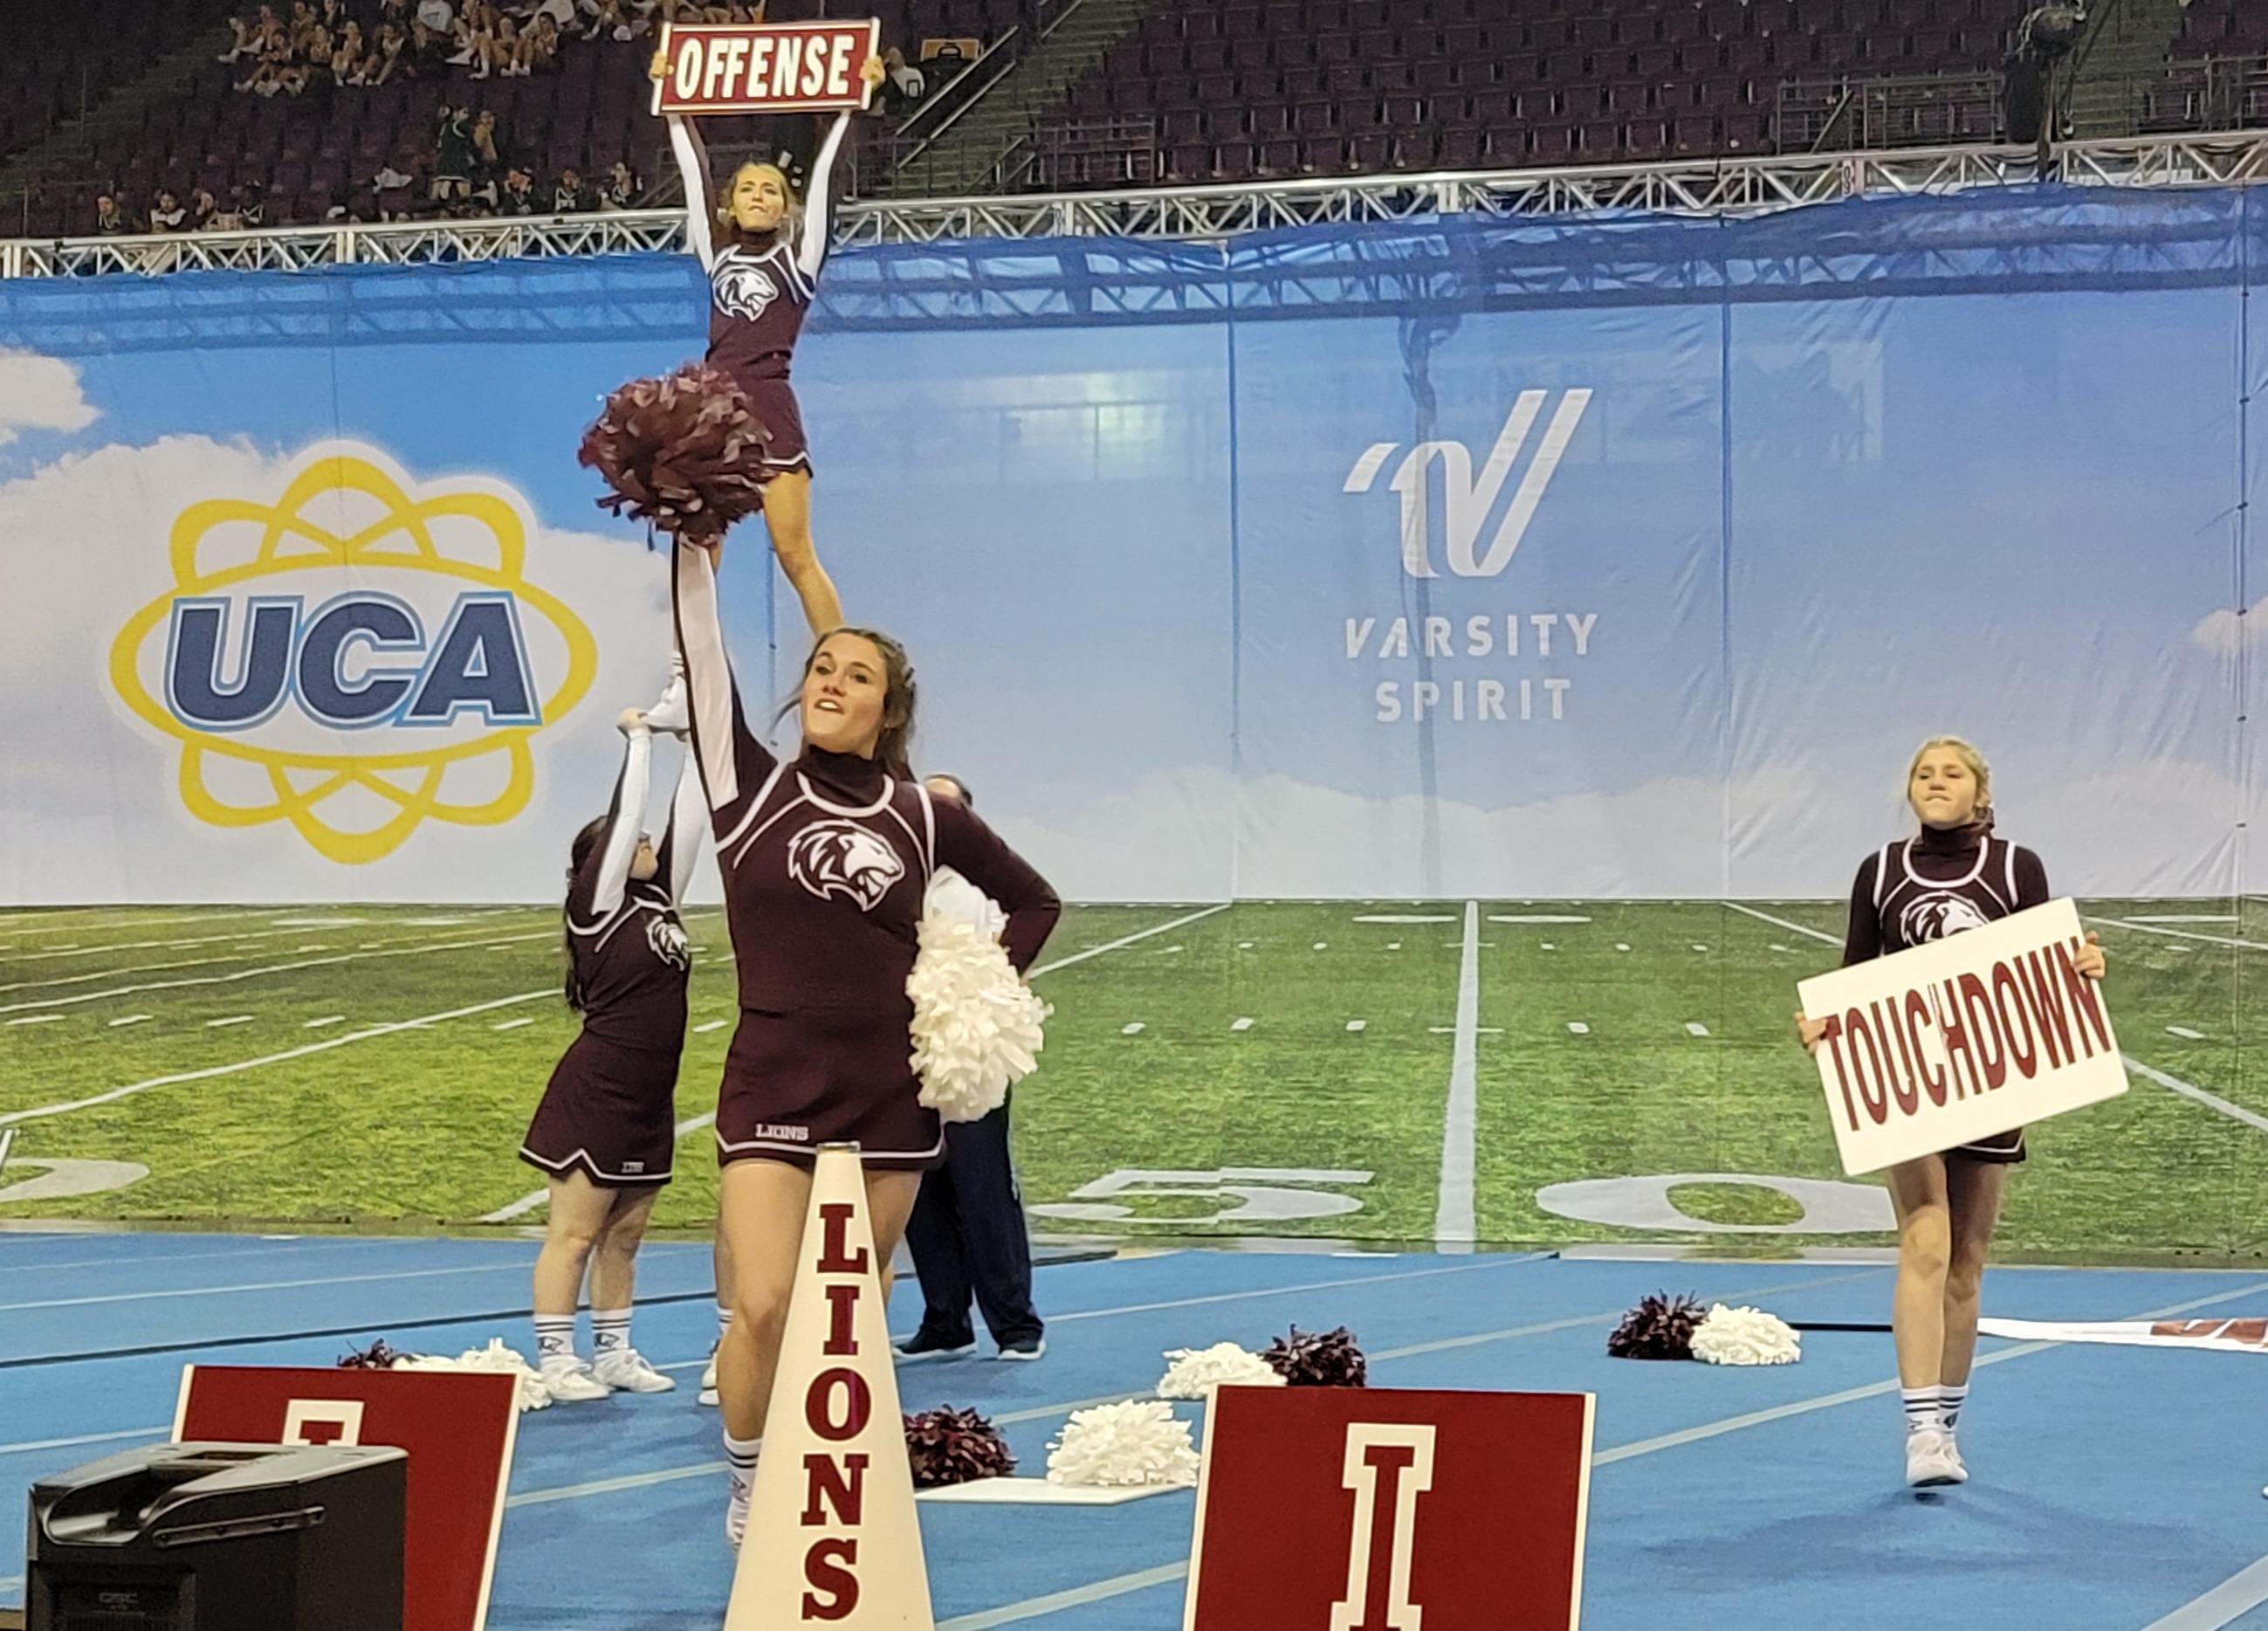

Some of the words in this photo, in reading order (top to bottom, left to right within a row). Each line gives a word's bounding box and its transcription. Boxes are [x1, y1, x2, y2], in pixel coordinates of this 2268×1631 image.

[675, 33, 856, 100] OFFENSE
[164, 590, 543, 733] UCA
[1345, 613, 1598, 659] VARSITY
[1375, 678, 1570, 723] SPIRIT
[1819, 935, 2113, 1132] TOUCHDOWN
[755, 1123, 809, 1141] LIONS
[800, 1202, 872, 1621] LIONS
